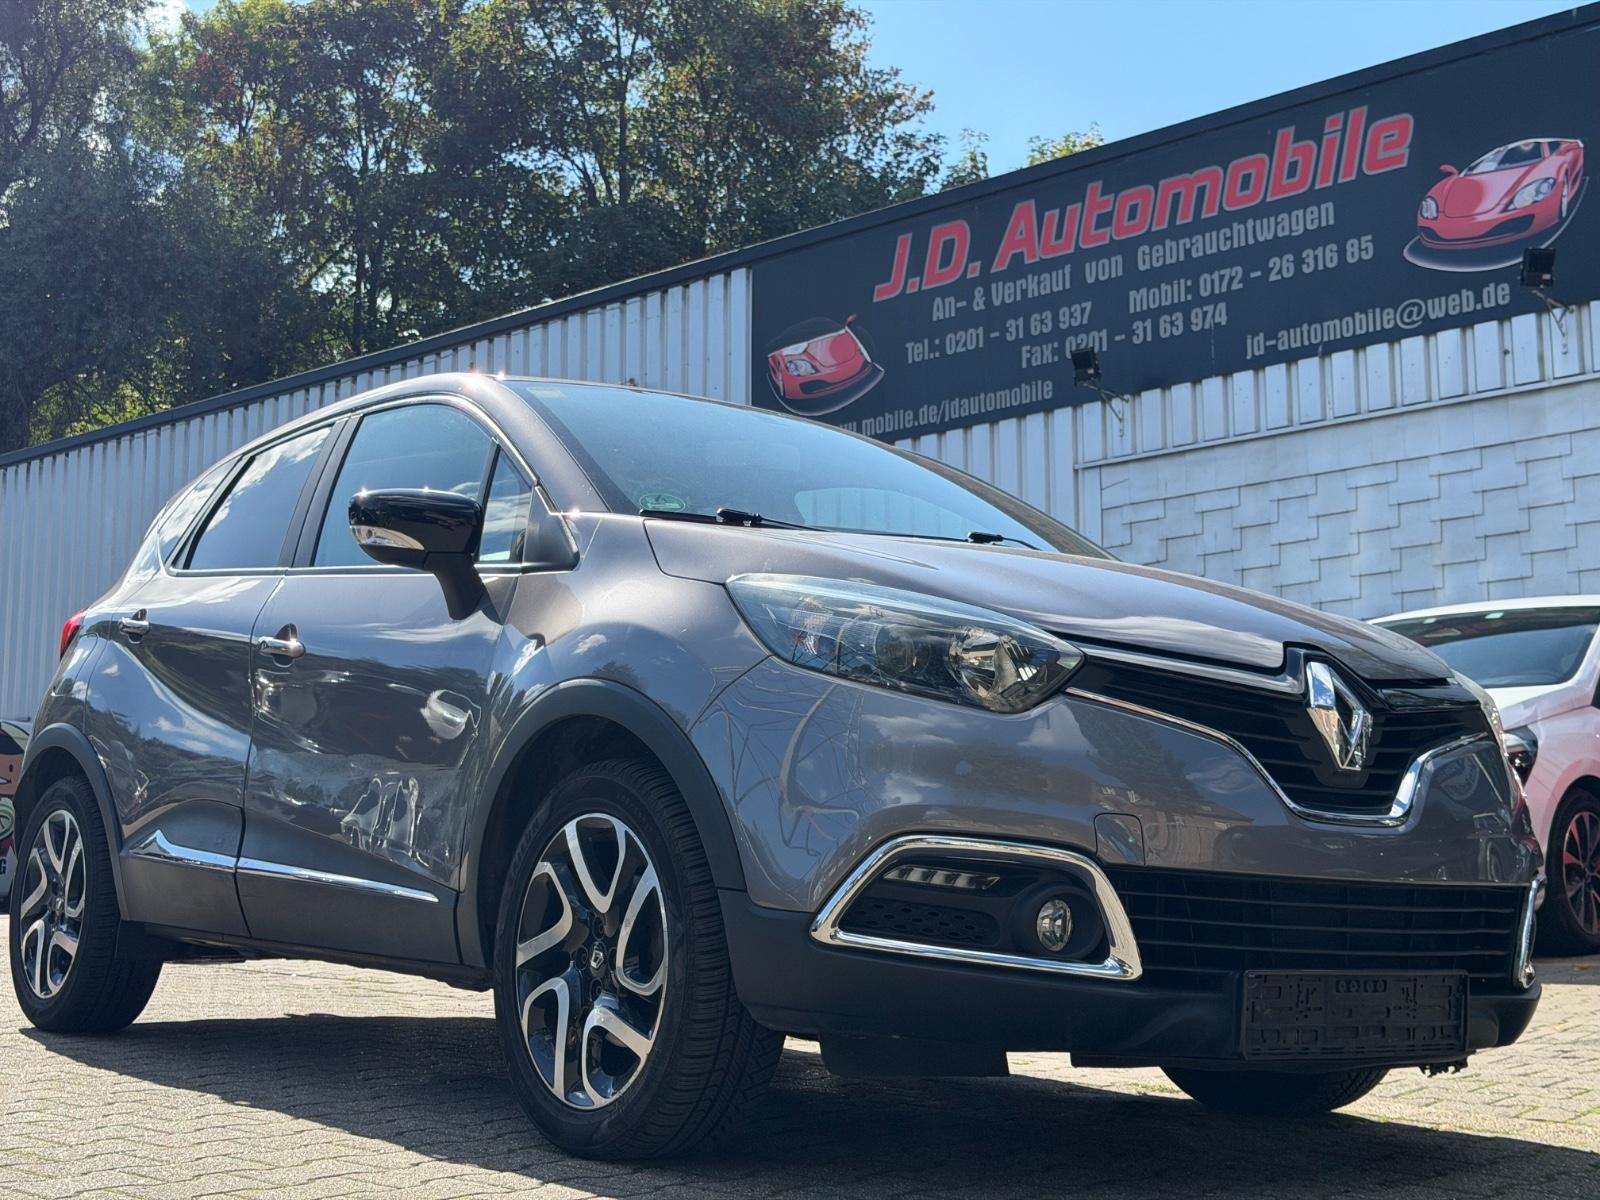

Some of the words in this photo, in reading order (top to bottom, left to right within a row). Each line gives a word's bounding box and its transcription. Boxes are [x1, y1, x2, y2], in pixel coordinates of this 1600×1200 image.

[873, 219, 982, 303] J.D.
[990, 105, 1414, 273] Automobile
[932, 296, 967, 321] An-
[973, 286, 986, 311] &
[991, 264, 1072, 307] Verkauf
[1085, 254, 1123, 283] von
[1137, 201, 1335, 271] Gebrauchtwagen
[1129, 278, 1192, 314] Mobil:
[1199, 265, 1243, 297] 0172
[1268, 254, 1295, 282] 26
[1302, 243, 1338, 274] 316
[1346, 234, 1374, 263] 85
[905, 338, 940, 364] Tel.:
[945, 326, 984, 355] 0201
[1006, 316, 1024, 342] 31
[1030, 310, 1052, 336] 63
[1059, 301, 1092, 330] 937
[1021, 342, 1059, 369] Fax:
[1132, 318, 1152, 344] 31
[1159, 312, 1184, 338] 63
[1190, 301, 1228, 332] 974
[1246, 282, 1511, 360] jd-automobile@web.de
